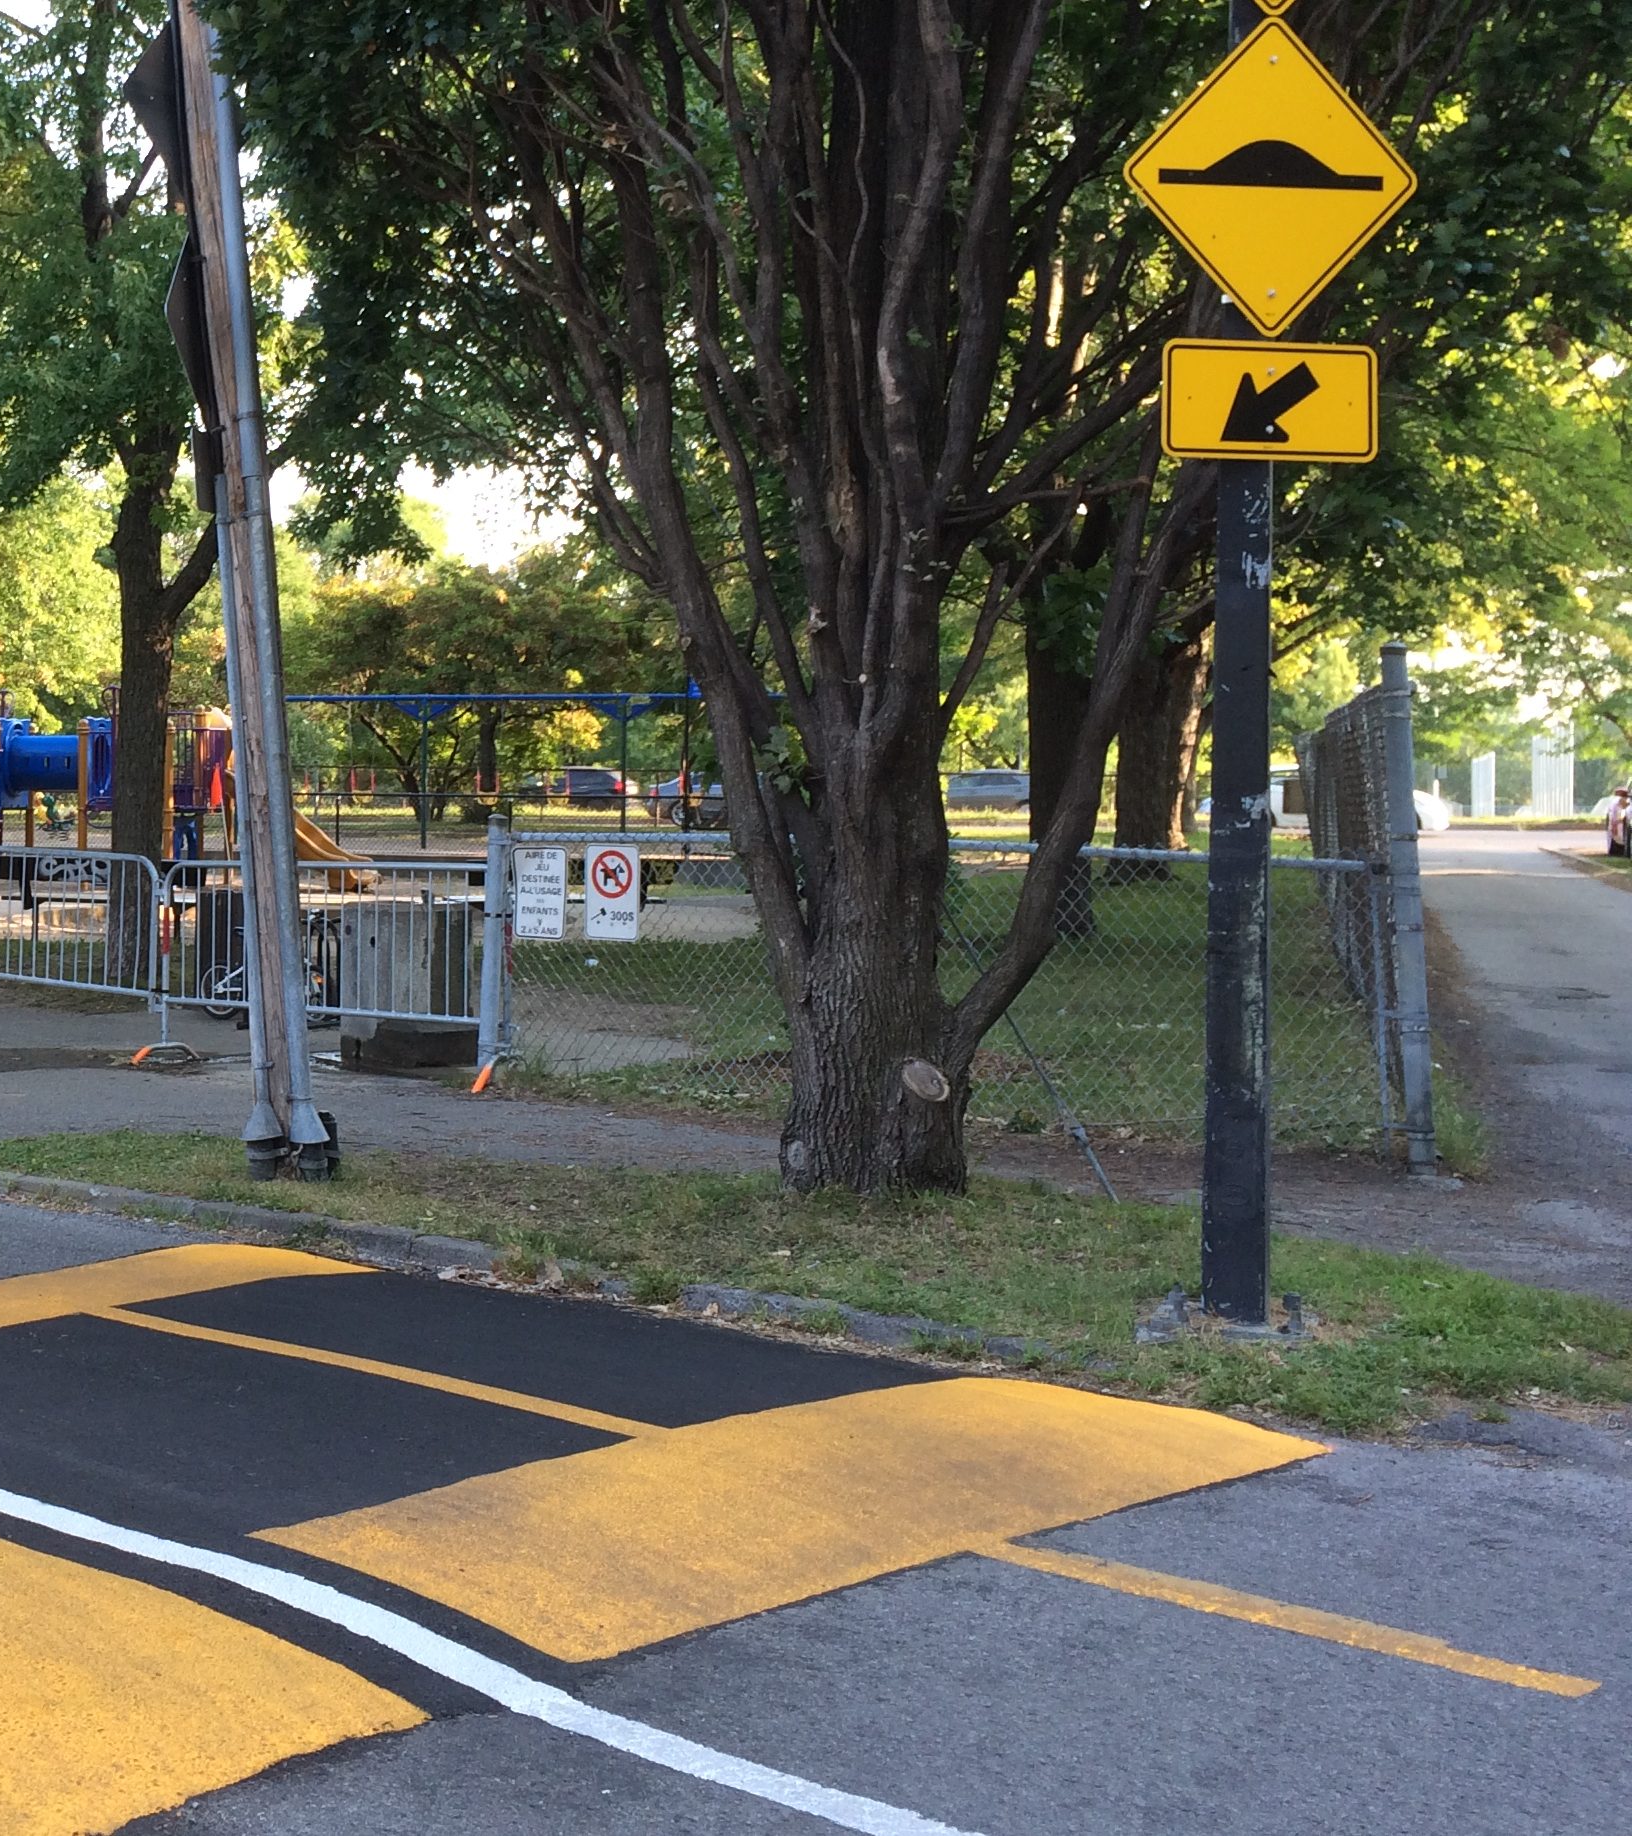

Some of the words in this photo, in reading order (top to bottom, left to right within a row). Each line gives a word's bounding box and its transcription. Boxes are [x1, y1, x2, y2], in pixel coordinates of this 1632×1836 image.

[546, 851, 557, 860] DE
[534, 863, 550, 871] JEU
[521, 906, 559, 916] ENFANTS
